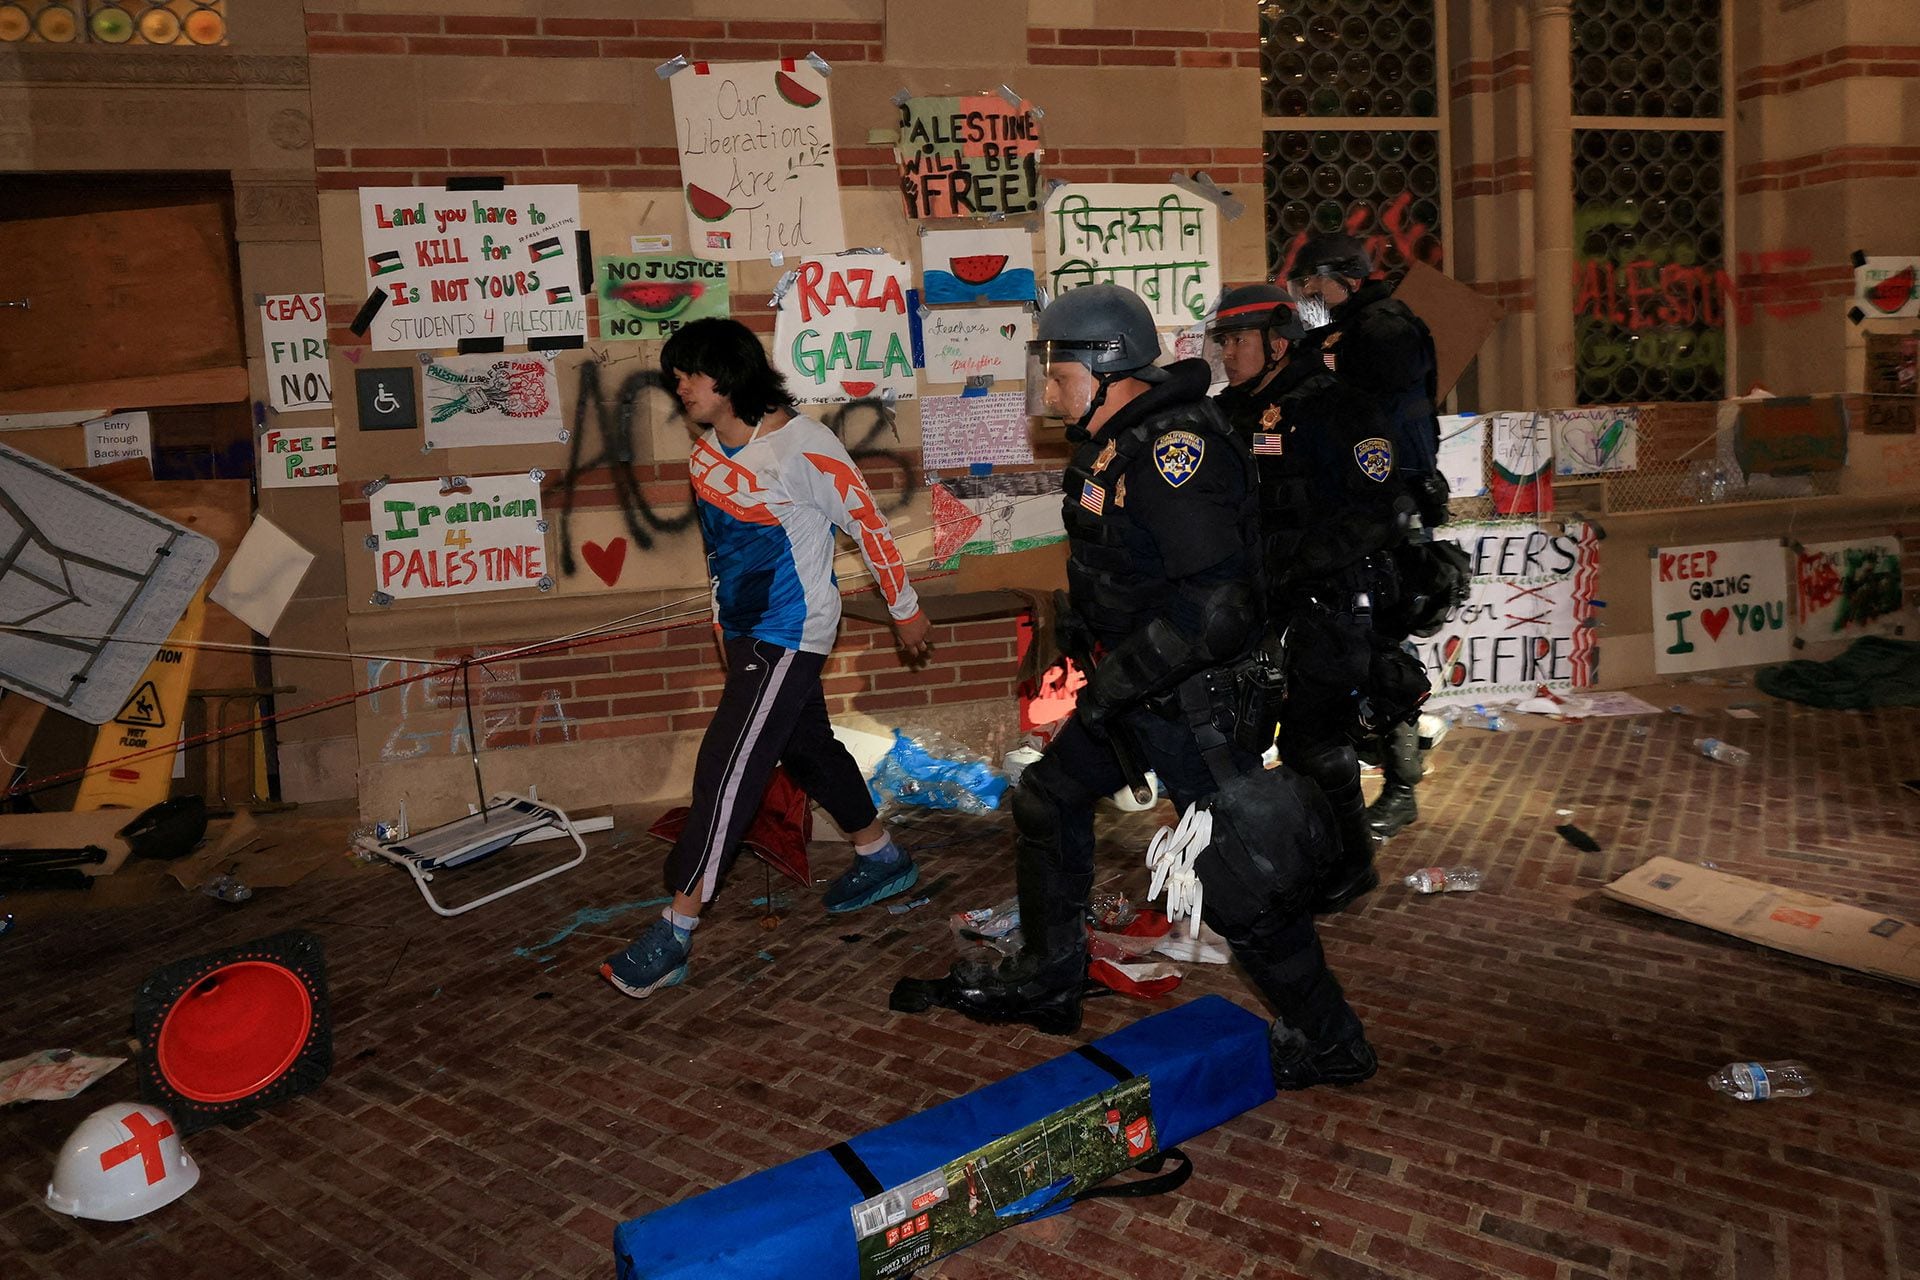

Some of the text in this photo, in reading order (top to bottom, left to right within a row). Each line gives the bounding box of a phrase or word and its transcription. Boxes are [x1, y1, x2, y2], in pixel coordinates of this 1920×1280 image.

[717, 80, 767, 120] Our
[685, 118, 820, 155] Liberations
[984, 142, 1019, 171] BE
[726, 158, 776, 198] Are
[923, 153, 1038, 214] FREE!
[374, 200, 546, 233] Land you have to
[733, 197, 812, 251] Tied
[415, 235, 512, 267] KILL for
[430, 278, 469, 302] NOT
[474, 270, 540, 300] YOURS
[608, 261, 726, 281] NO JUSTICE
[796, 261, 906, 322] RAZA
[1572, 247, 1824, 330] ALESTINE
[266, 294, 325, 322] CEAS
[388, 308, 585, 342] STUDENTS 4 PALESTINE
[611, 319, 642, 337] NO
[928, 317, 990, 336] teachers
[791, 329, 914, 385] GAZA
[950, 354, 1002, 375] palestine
[427, 364, 468, 384] PALESTINA
[487, 361, 510, 378] FREE
[97, 434, 138, 445] Through
[104, 421, 130, 432] Entry
[944, 415, 1032, 452] GAZA
[1498, 416, 1548, 442] FREE
[94, 448, 143, 458] Back with
[267, 431, 314, 453] FREE
[1499, 443, 1541, 458] GAZA
[384, 495, 537, 541] Iranian
[444, 529, 472, 550] 4
[382, 545, 543, 589] PALESTINE
[1659, 550, 1718, 582] KEEP
[1689, 574, 1751, 600] GOING
[1666, 601, 1783, 654] I YOU
[119, 737, 148, 749] FLOOR
[127, 728, 146, 738] WET
